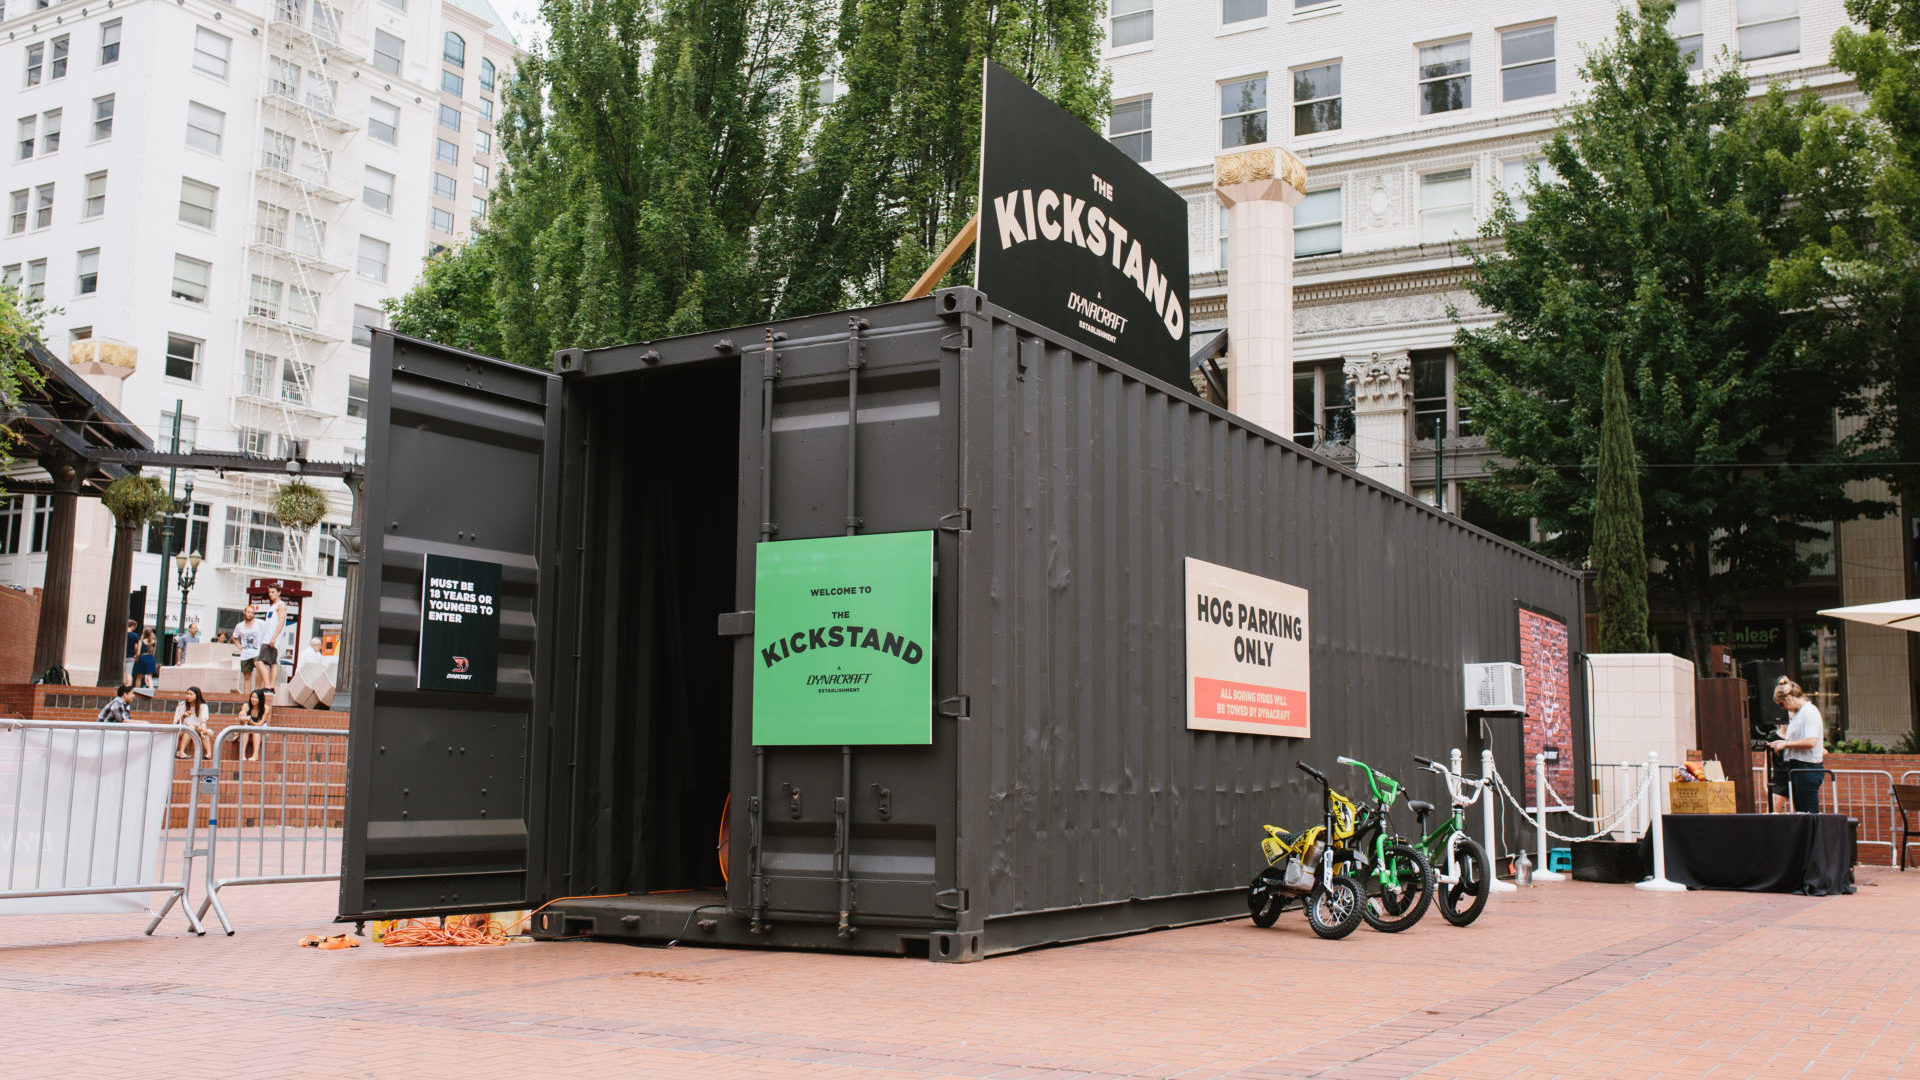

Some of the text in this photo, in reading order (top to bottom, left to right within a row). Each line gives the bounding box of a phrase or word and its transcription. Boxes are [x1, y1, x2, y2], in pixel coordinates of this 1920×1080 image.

[1092, 173, 1113, 202] THE
[993, 188, 1184, 341] KICKSTAND
[1096, 291, 1102, 300] A
[1067, 291, 1128, 334] DYNACRAFT
[1079, 320, 1117, 343] ESTABLISHMENT
[430, 577, 474, 592] MUST BE
[810, 586, 872, 597] WELCOME TO
[429, 588, 492, 604] 18 YEARS OR
[428, 611, 462, 623] ENTER
[429, 600, 494, 616] YOUNGER TO
[831, 610, 850, 619] THE
[1197, 593, 1303, 642] HOG PARKING
[761, 625, 923, 669] KICKSTAND
[1233, 635, 1274, 668] ONLY
[806, 673, 873, 686] DYNACRAFT
[1220, 687, 1288, 706] ALL BORING RIDES WILL
[1216, 703, 1291, 721] BE TOWED BY DYNACRAFT
